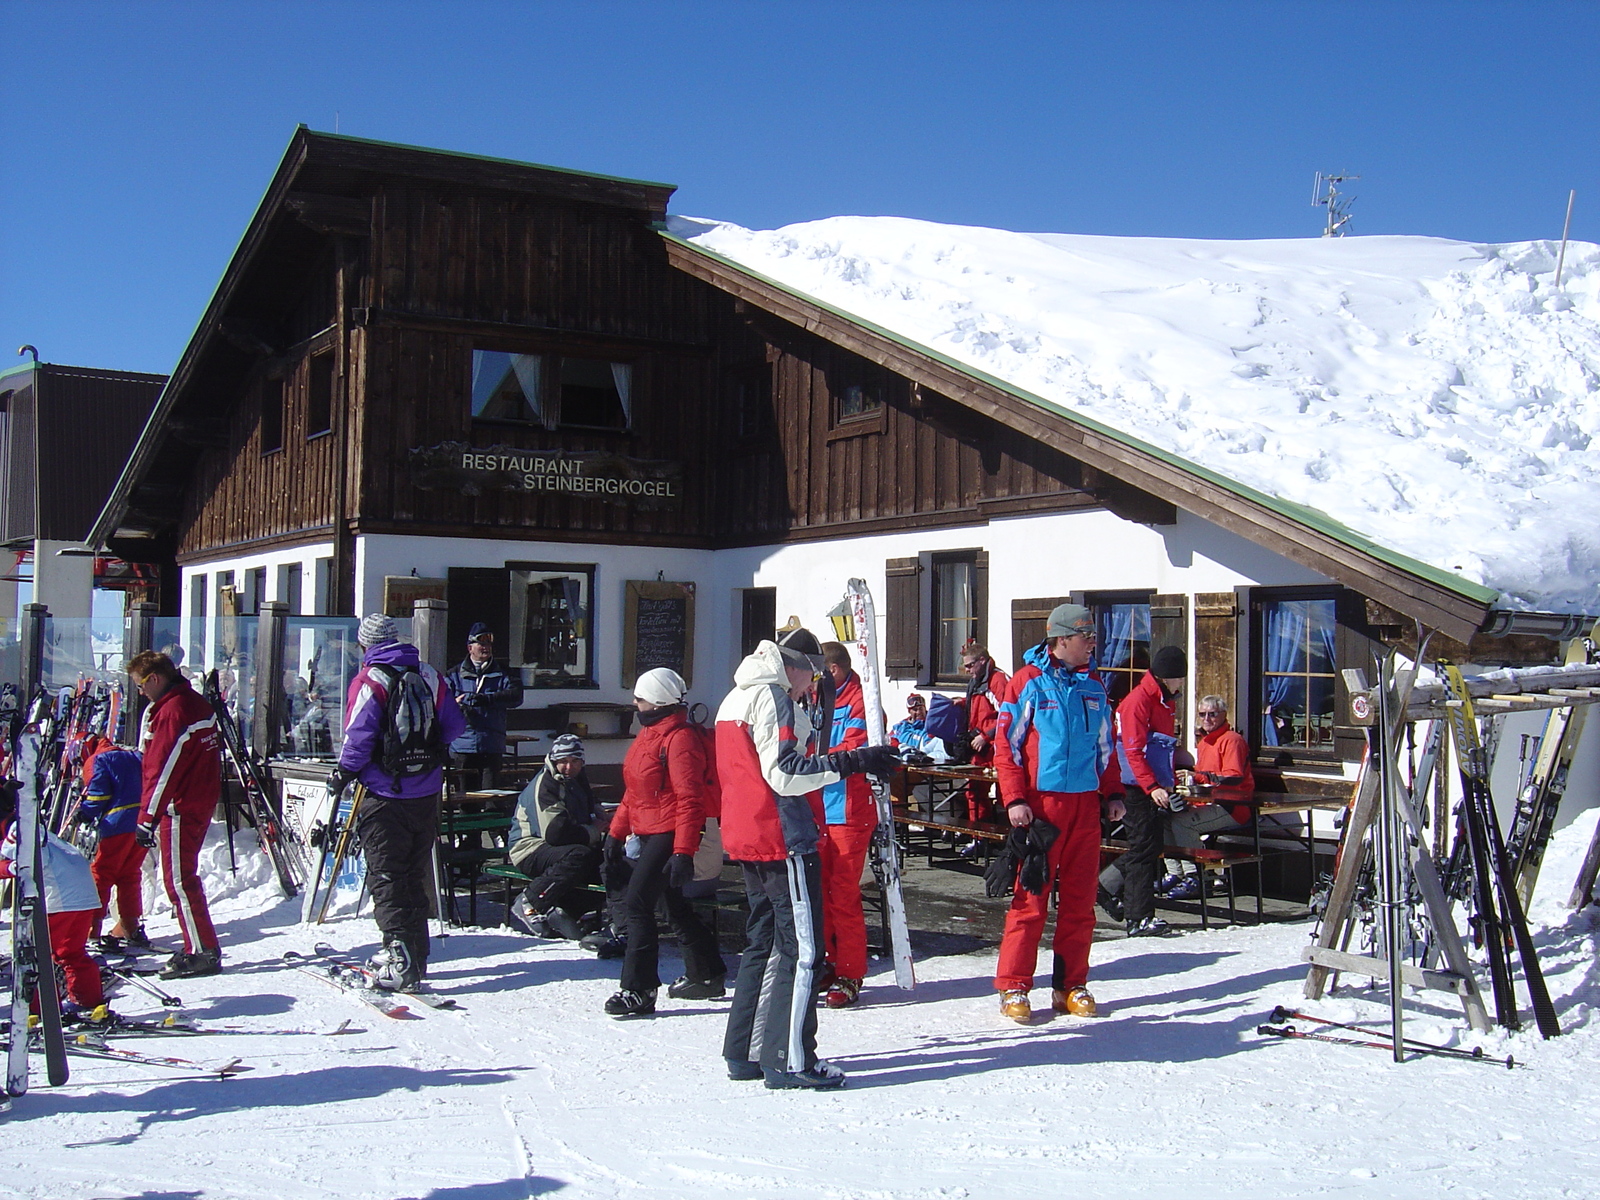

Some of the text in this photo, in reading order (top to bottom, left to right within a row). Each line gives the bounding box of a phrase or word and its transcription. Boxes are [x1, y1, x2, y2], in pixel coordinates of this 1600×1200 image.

[462, 454, 584, 475] RESTAURANT
[524, 475, 675, 497] STEINBERGKOGEL
[1450, 691, 1472, 775] ATOMI
